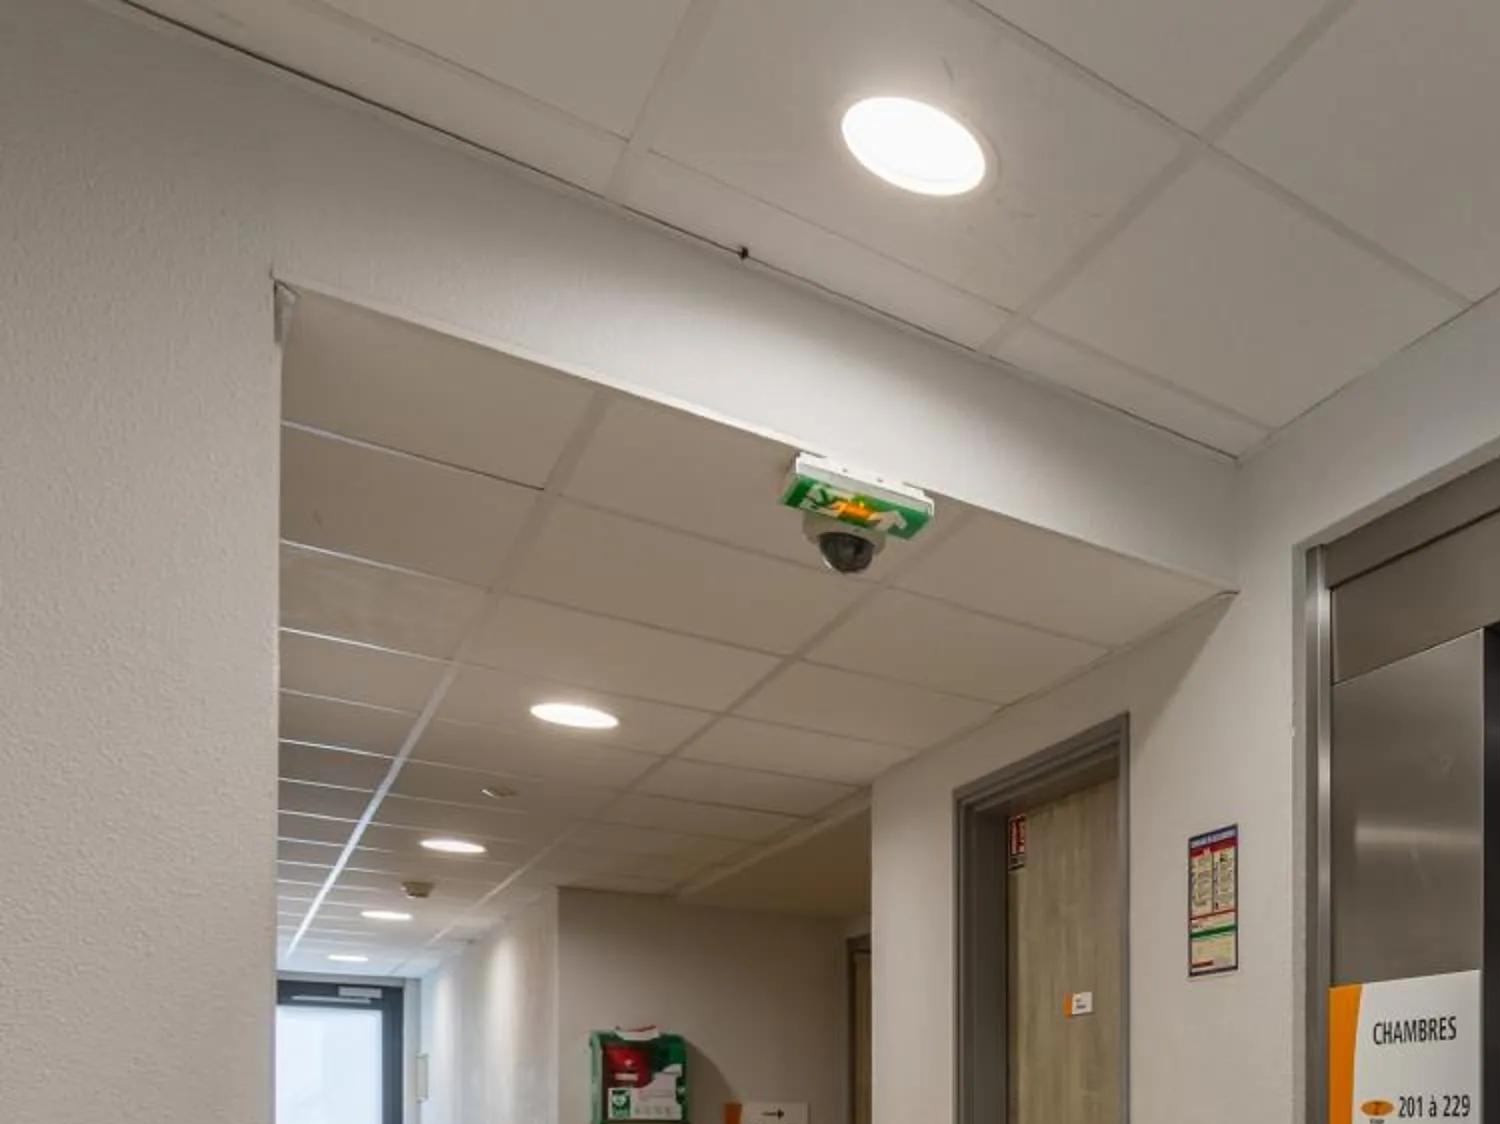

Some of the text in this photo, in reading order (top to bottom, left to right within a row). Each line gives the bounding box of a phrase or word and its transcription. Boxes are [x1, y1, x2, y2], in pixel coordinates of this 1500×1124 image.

[1373, 1015, 1457, 1045] CHAMBRES
[1398, 1095, 1424, 1118] 201
[1428, 1094, 1438, 1117] à
[1443, 1094, 1471, 1117] 229
